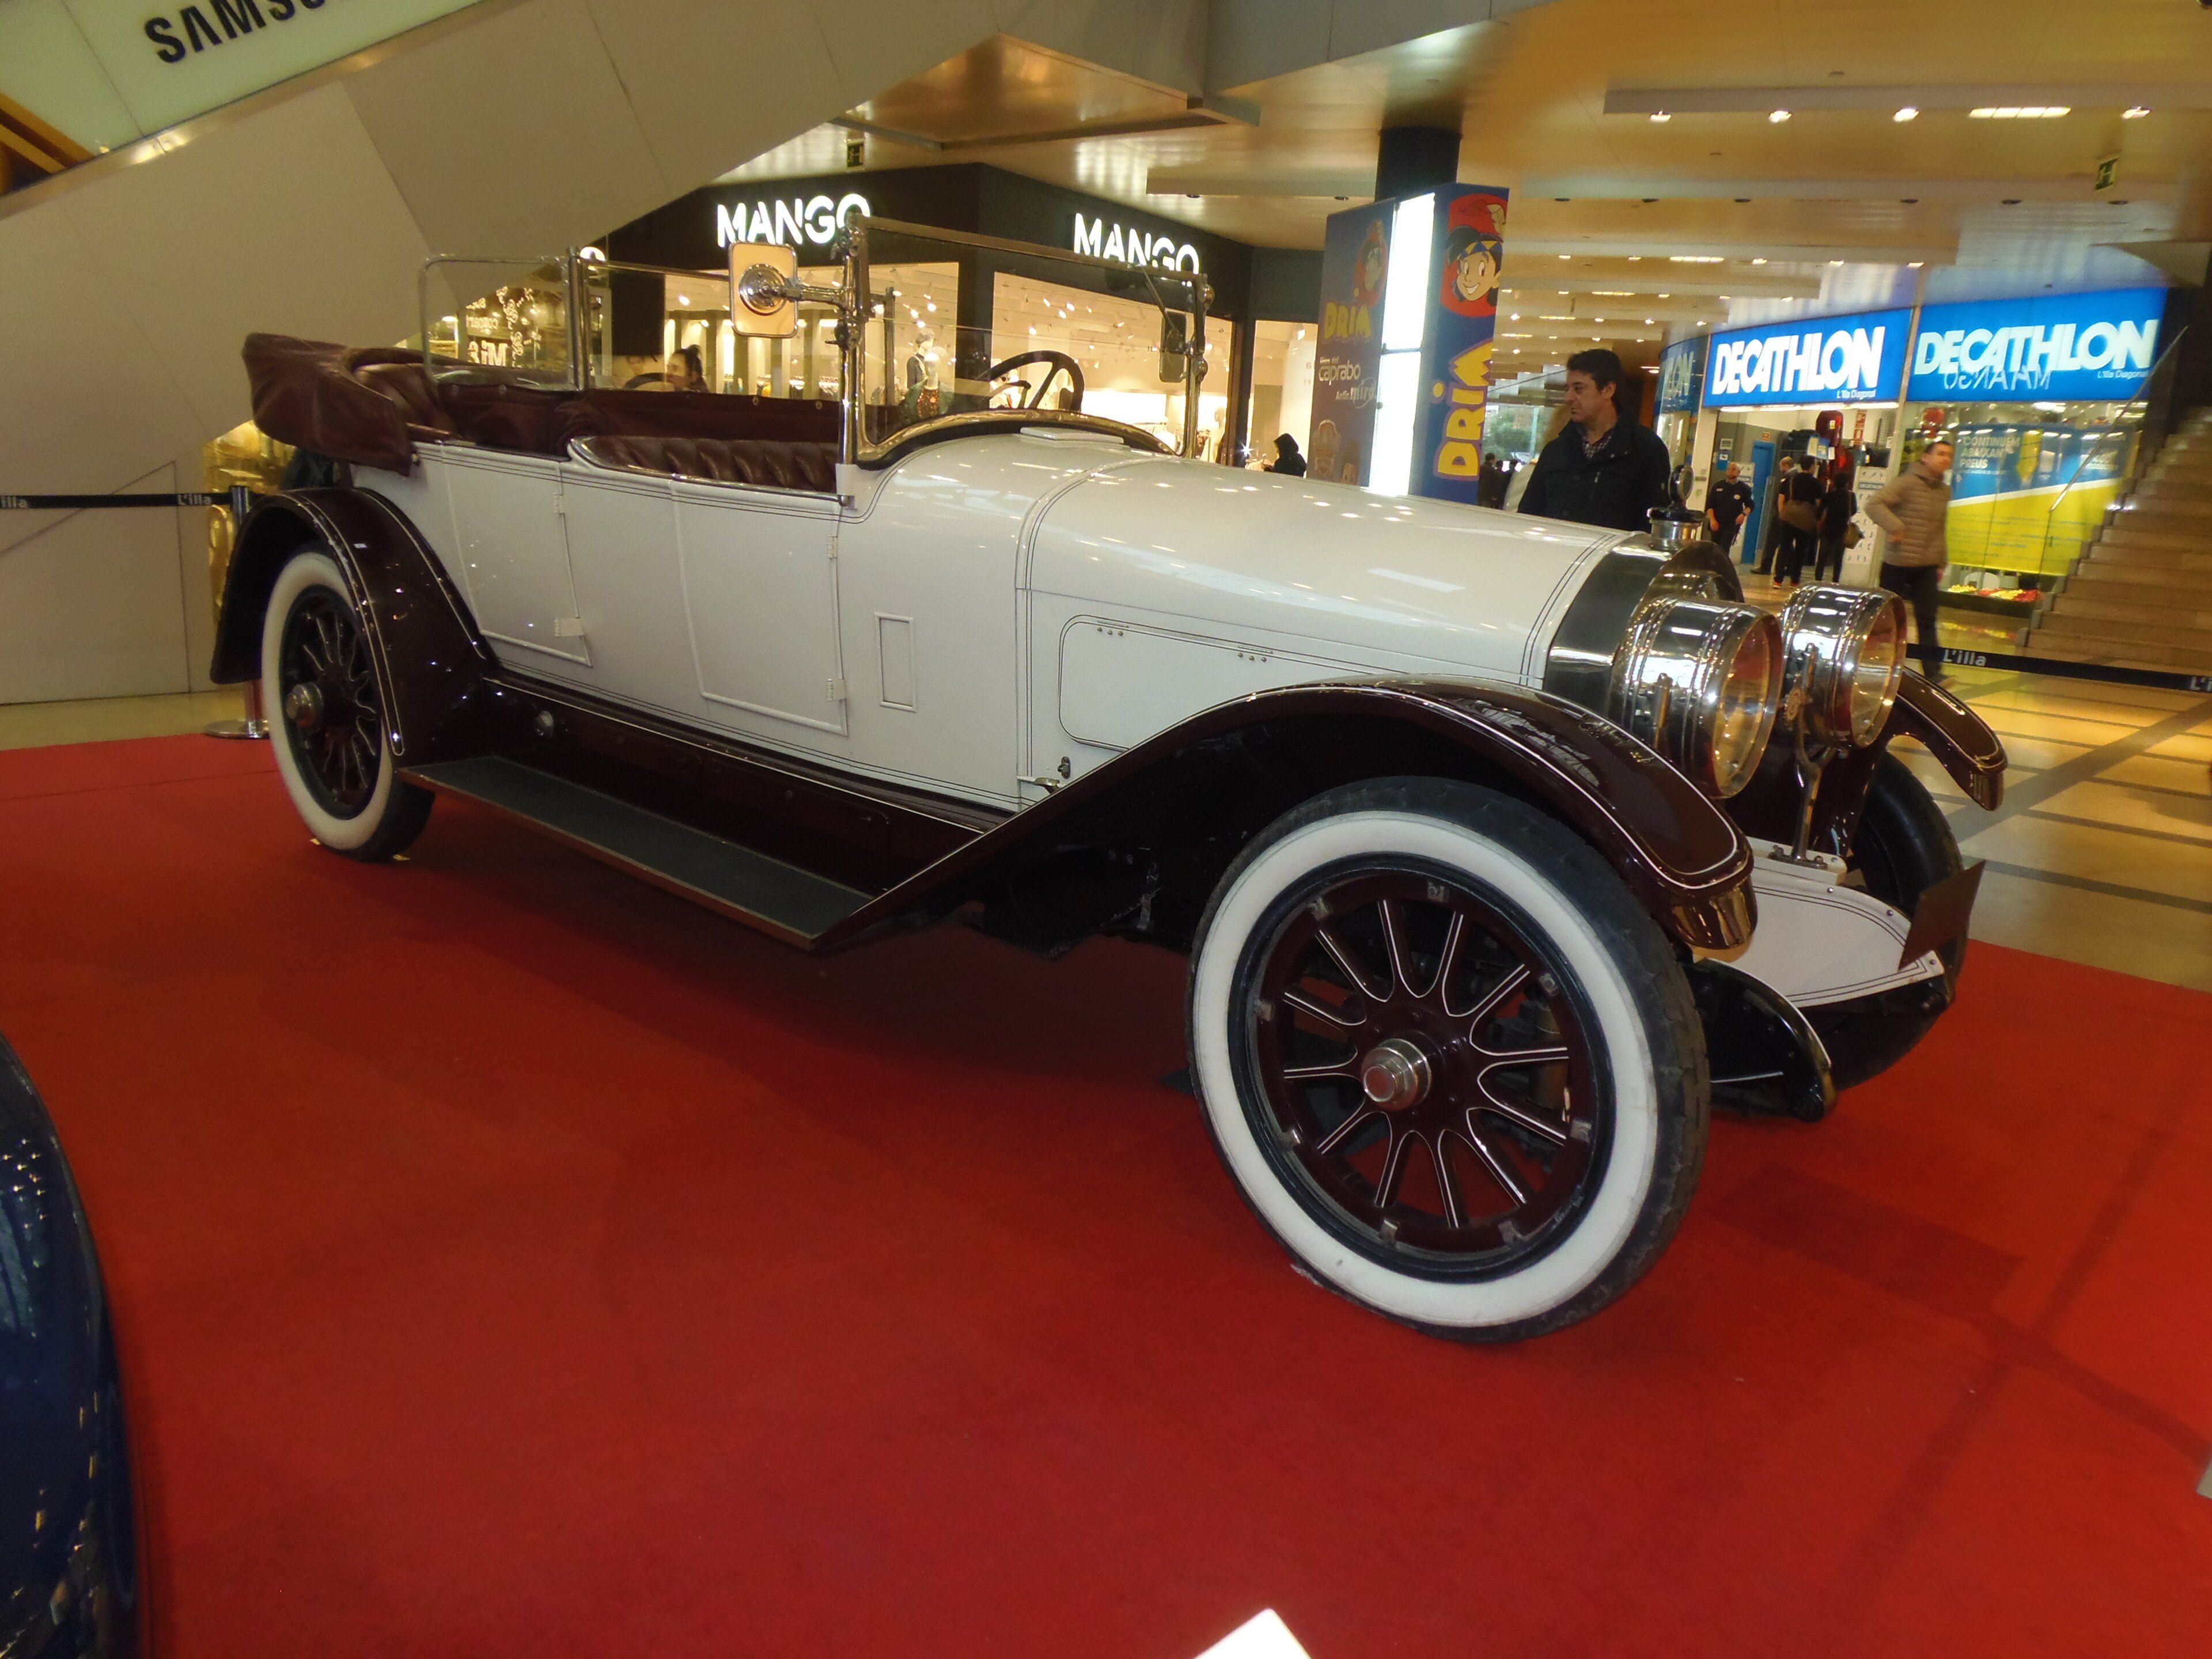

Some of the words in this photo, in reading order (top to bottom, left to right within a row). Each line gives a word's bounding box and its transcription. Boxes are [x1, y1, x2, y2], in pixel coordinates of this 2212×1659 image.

[1073, 213, 1200, 287] MANGO
[1712, 326, 1885, 395] DECATHLON
[1914, 319, 2159, 375] DECATHLON
[1319, 359, 1361, 386] caprabo
[1960, 459, 1988, 469] PREUS
[1943, 649, 1987, 666] L'illa
